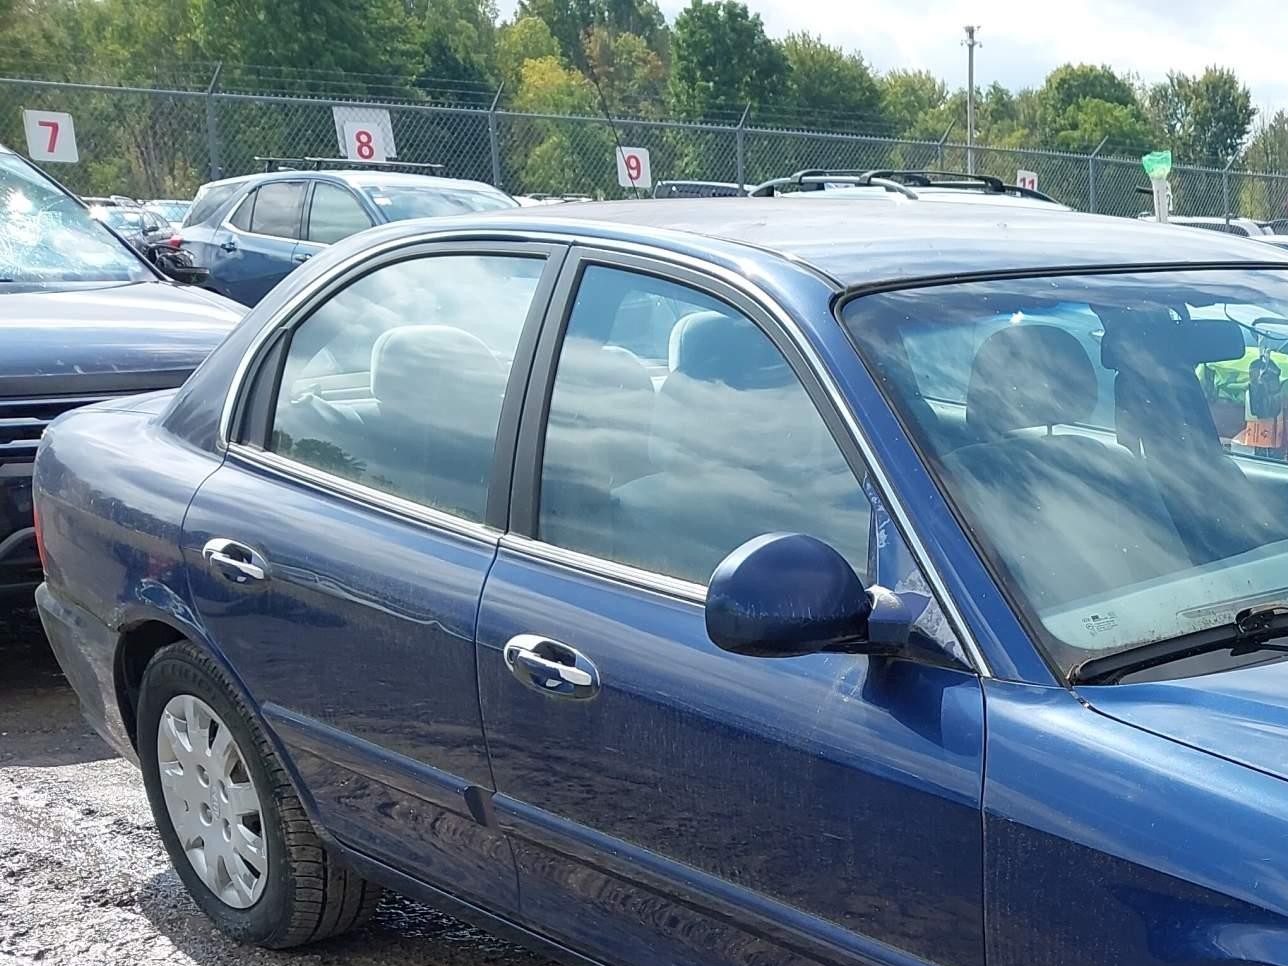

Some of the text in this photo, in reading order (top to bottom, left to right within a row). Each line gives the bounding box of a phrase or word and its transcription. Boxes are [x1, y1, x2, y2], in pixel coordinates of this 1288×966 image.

[38, 121, 59, 153] 7
[355, 130, 375, 160] 8
[626, 155, 641, 180] 9
[1020, 176, 1035, 190] 11
